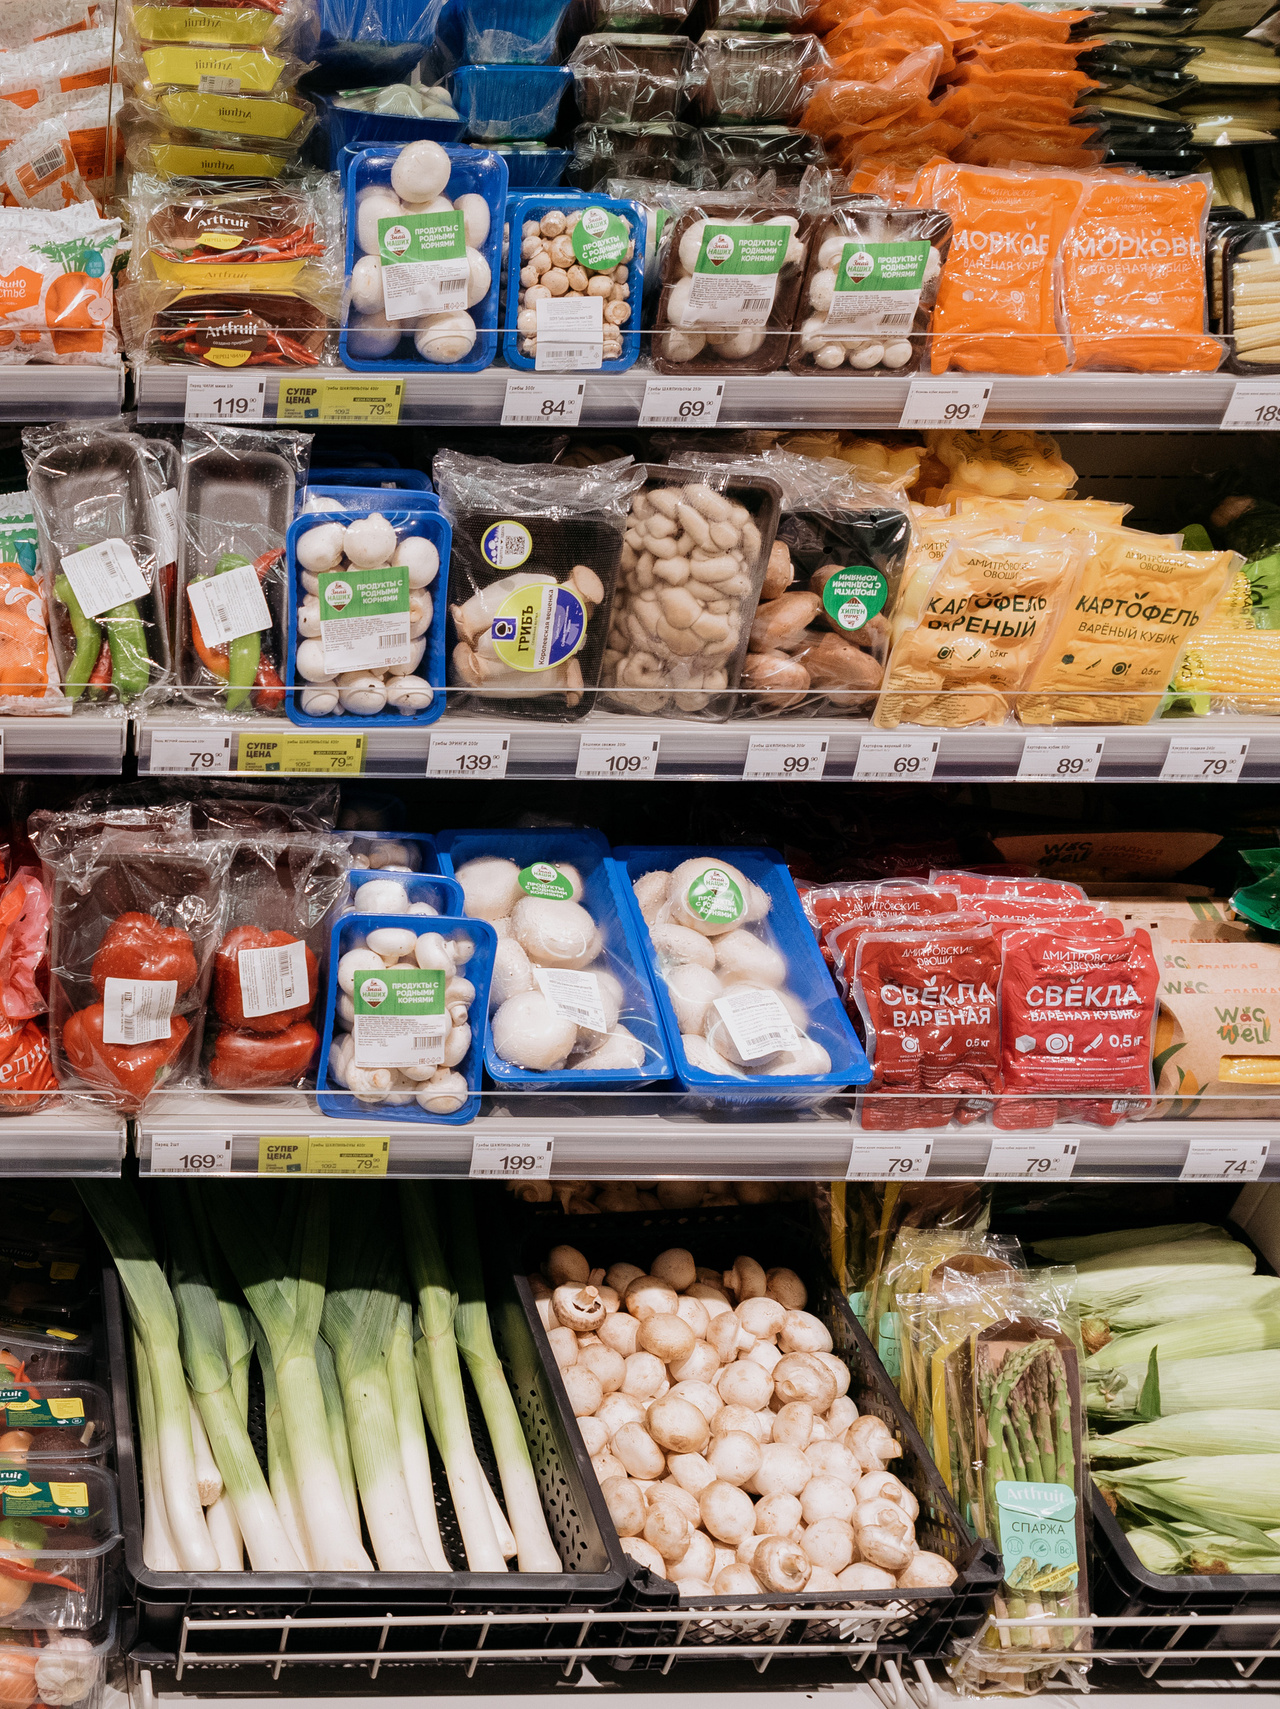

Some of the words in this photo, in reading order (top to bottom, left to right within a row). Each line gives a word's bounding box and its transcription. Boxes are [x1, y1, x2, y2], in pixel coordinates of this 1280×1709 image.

[197, 214, 250, 229] Artfruit
[415, 226, 453, 236] ПРОДУКТЫ
[419, 232, 455, 242] РОДНЫМИ
[386, 239, 410, 247] НАШИХ
[421, 240, 455, 250] КОРНЯМИ
[738, 239, 776, 247] ПРОДУКТЫ
[707, 248, 732, 256] НАШИХ
[741, 246, 778, 255] РОДНЫМИ
[741, 254, 775, 262] КОРНЯМИ
[206, 321, 259, 339] Artfruit
[286, 388, 318, 396] СУПЕР
[212, 397, 249, 413] 119
[285, 396, 311, 404] ЦЕНА
[369, 404, 385, 415] 79
[540, 399, 566, 416] 84
[678, 400, 705, 417] 69
[943, 403, 971, 420] 99
[1139, 562, 1174, 574] ОВОЩИ
[839, 573, 878, 582] КОРНЯМИ
[356, 581, 396, 591] ПРОДУКТЫ
[832, 581, 873, 589] РОДНЫМИ
[875, 581, 881, 589] С
[361, 587, 399, 597] РОДНЫМИ
[834, 588, 877, 596] ПРОДУКТЫ
[363, 595, 398, 604] КОРНЯМИ
[1075, 595, 1200, 627] КАРТОФЕЛЬ
[518, 605, 534, 652] ГРИБЪ
[538, 619, 550, 665] Королевская
[546, 589, 554, 618] вешенка
[1078, 621, 1138, 641] ВАРЁНЫЙ
[1140, 630, 1180, 645] КУБИК
[247, 742, 278, 750] СУПЕР
[246, 750, 272, 758] ЦЕНА
[189, 753, 215, 768] 79
[330, 757, 346, 767] 79
[455, 754, 492, 770] 139
[605, 756, 642, 771] 109
[783, 757, 809, 773] 99
[893, 757, 920, 773] 69
[1056, 758, 1083, 774] 89
[1201, 760, 1228, 774] 79
[396, 989, 435, 997] РОДНЫМИ
[398, 996, 434, 1004] КОРНЯМИ
[965, 1038, 980, 1048] 0,5
[980, 1039, 990, 1048] кг
[1109, 1034, 1132, 1048] 0,5
[267, 1145, 298, 1153] СУПЕР
[179, 1154, 215, 1169] 169
[267, 1152, 292, 1161] ЦЕНА
[356, 1160, 372, 1169] 79
[499, 1155, 535, 1170] 199
[888, 1158, 913, 1173] 79
[1026, 1158, 1051, 1173] 79
[1223, 1159, 1248, 1174] 74
[1007, 1486, 1065, 1504] Artfruit
[1011, 1521, 1066, 1535] СПАРЖА
